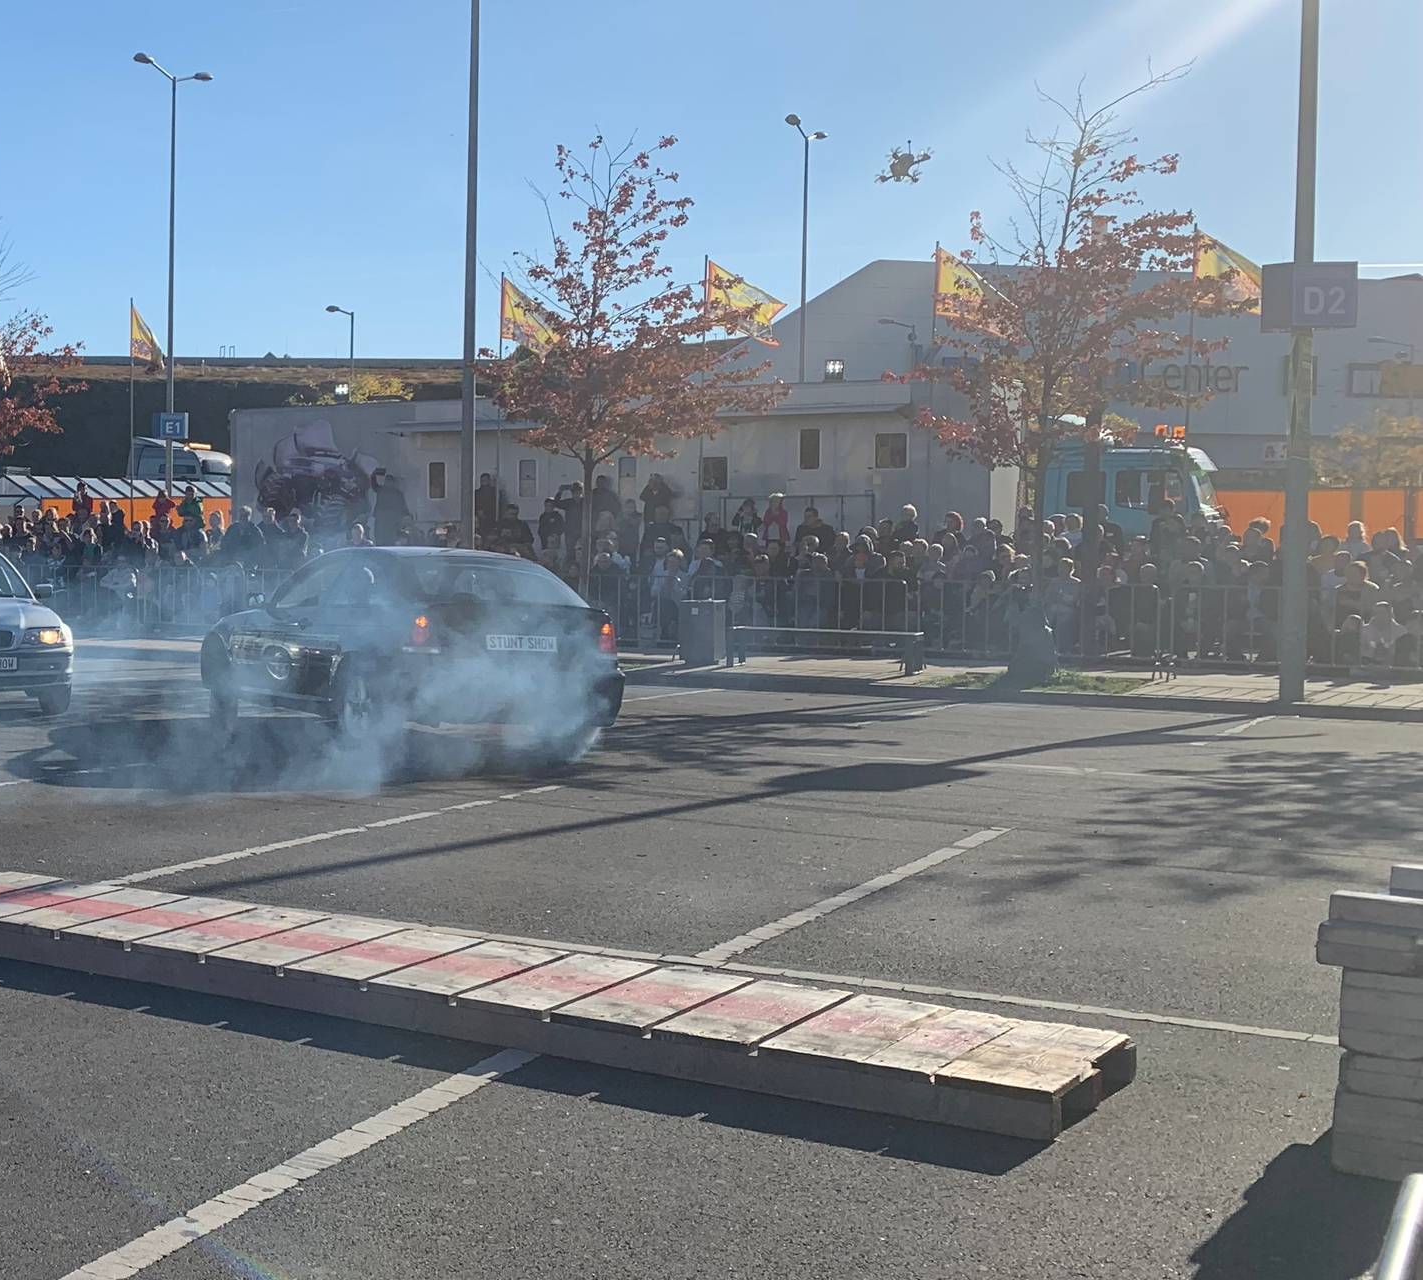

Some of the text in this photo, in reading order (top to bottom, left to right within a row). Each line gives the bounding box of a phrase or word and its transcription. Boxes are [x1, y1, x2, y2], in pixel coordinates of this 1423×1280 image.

[1304, 286, 1346, 314] D2
[166, 421, 180, 434] E1
[488, 636, 554, 650] STUNT SHOW
